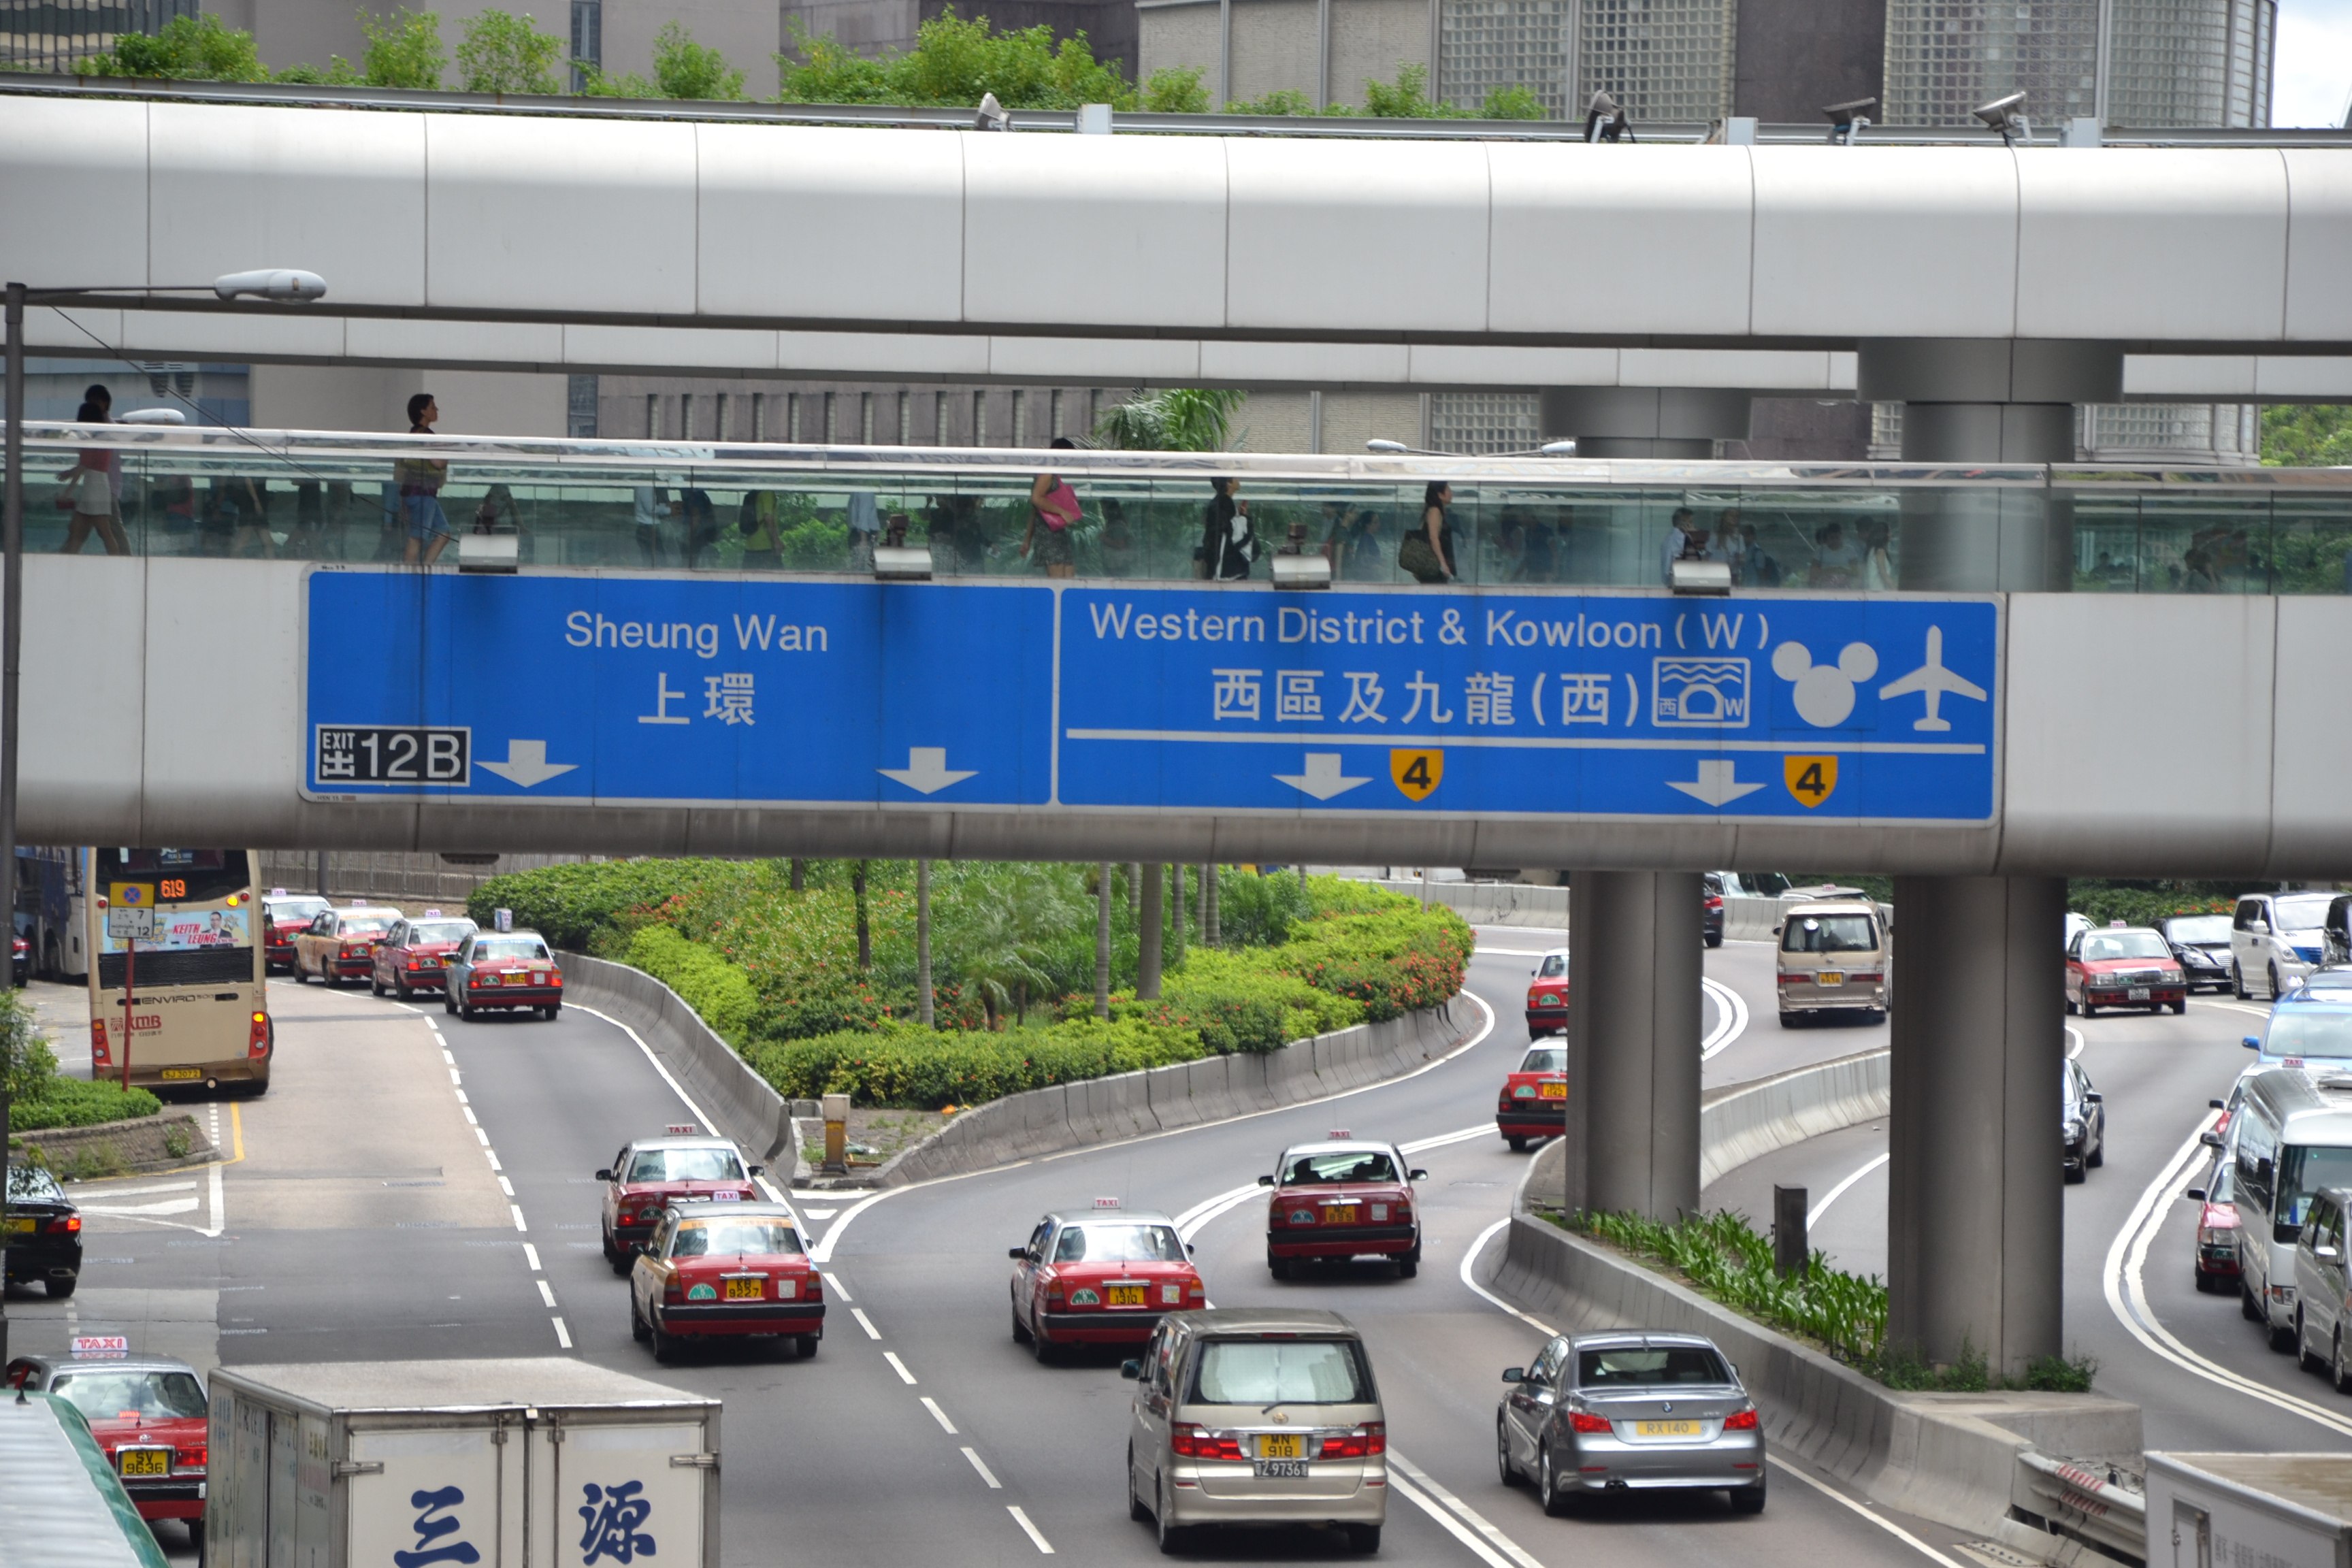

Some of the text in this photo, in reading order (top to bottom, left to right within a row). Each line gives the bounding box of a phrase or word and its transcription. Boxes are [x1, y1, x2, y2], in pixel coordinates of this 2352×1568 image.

[1090, 603, 1769, 650] Western District & Kowloon (W)
[565, 611, 828, 659] Sheung Wan
[638, 672, 755, 726] 上環
[1211, 668, 1639, 727] 西區及九龍(西)
[1659, 698, 1677, 717] 西
[1725, 698, 1744, 717] W
[322, 732, 356, 749] EXIT
[361, 732, 461, 779] 12B
[322, 751, 355, 777] 出
[1401, 756, 1432, 790] 4
[1795, 762, 1827, 797] 4
[161, 879, 186, 898] 619
[137, 910, 144, 919] 7
[137, 926, 150, 936] 12
[173, 923, 201, 935] KEITH
[187, 933, 218, 945] LEUNG
[142, 994, 195, 1005] ENVIRO
[178, 1070, 199, 1078] 3072
[729, 1288, 759, 1298] 9227
[1115, 1294, 1138, 1304] 1310
[78, 1339, 122, 1349] TAXI
[1646, 1422, 1689, 1434] RX 140
[1271, 1434, 1290, 1444] MN
[135, 1452, 154, 1463] SV
[1268, 1446, 1293, 1458] 918
[126, 1463, 163, 1474] 9636
